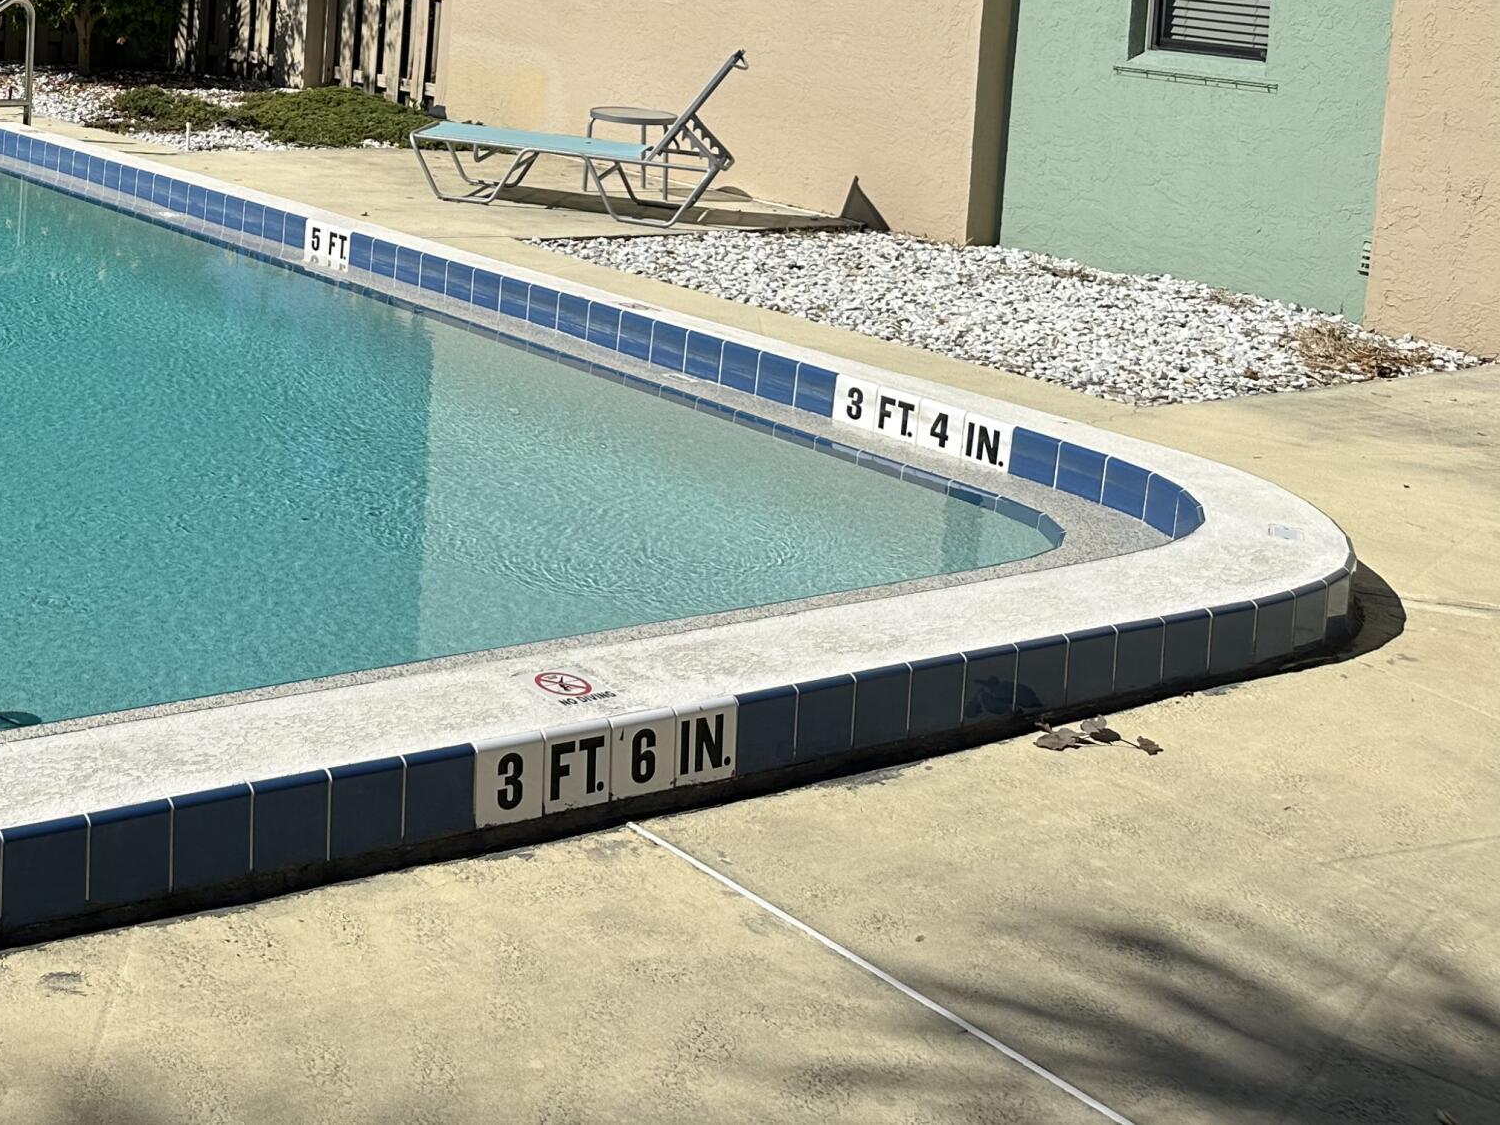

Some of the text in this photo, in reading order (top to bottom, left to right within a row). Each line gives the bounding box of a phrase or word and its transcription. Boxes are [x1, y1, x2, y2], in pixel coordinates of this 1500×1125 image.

[311, 227, 347, 260] 5 FT.
[846, 387, 1004, 467] 3 FT. 4 IN.
[558, 690, 617, 707] NO DIVING
[497, 713, 732, 811] 3 FT. 6 IN.
